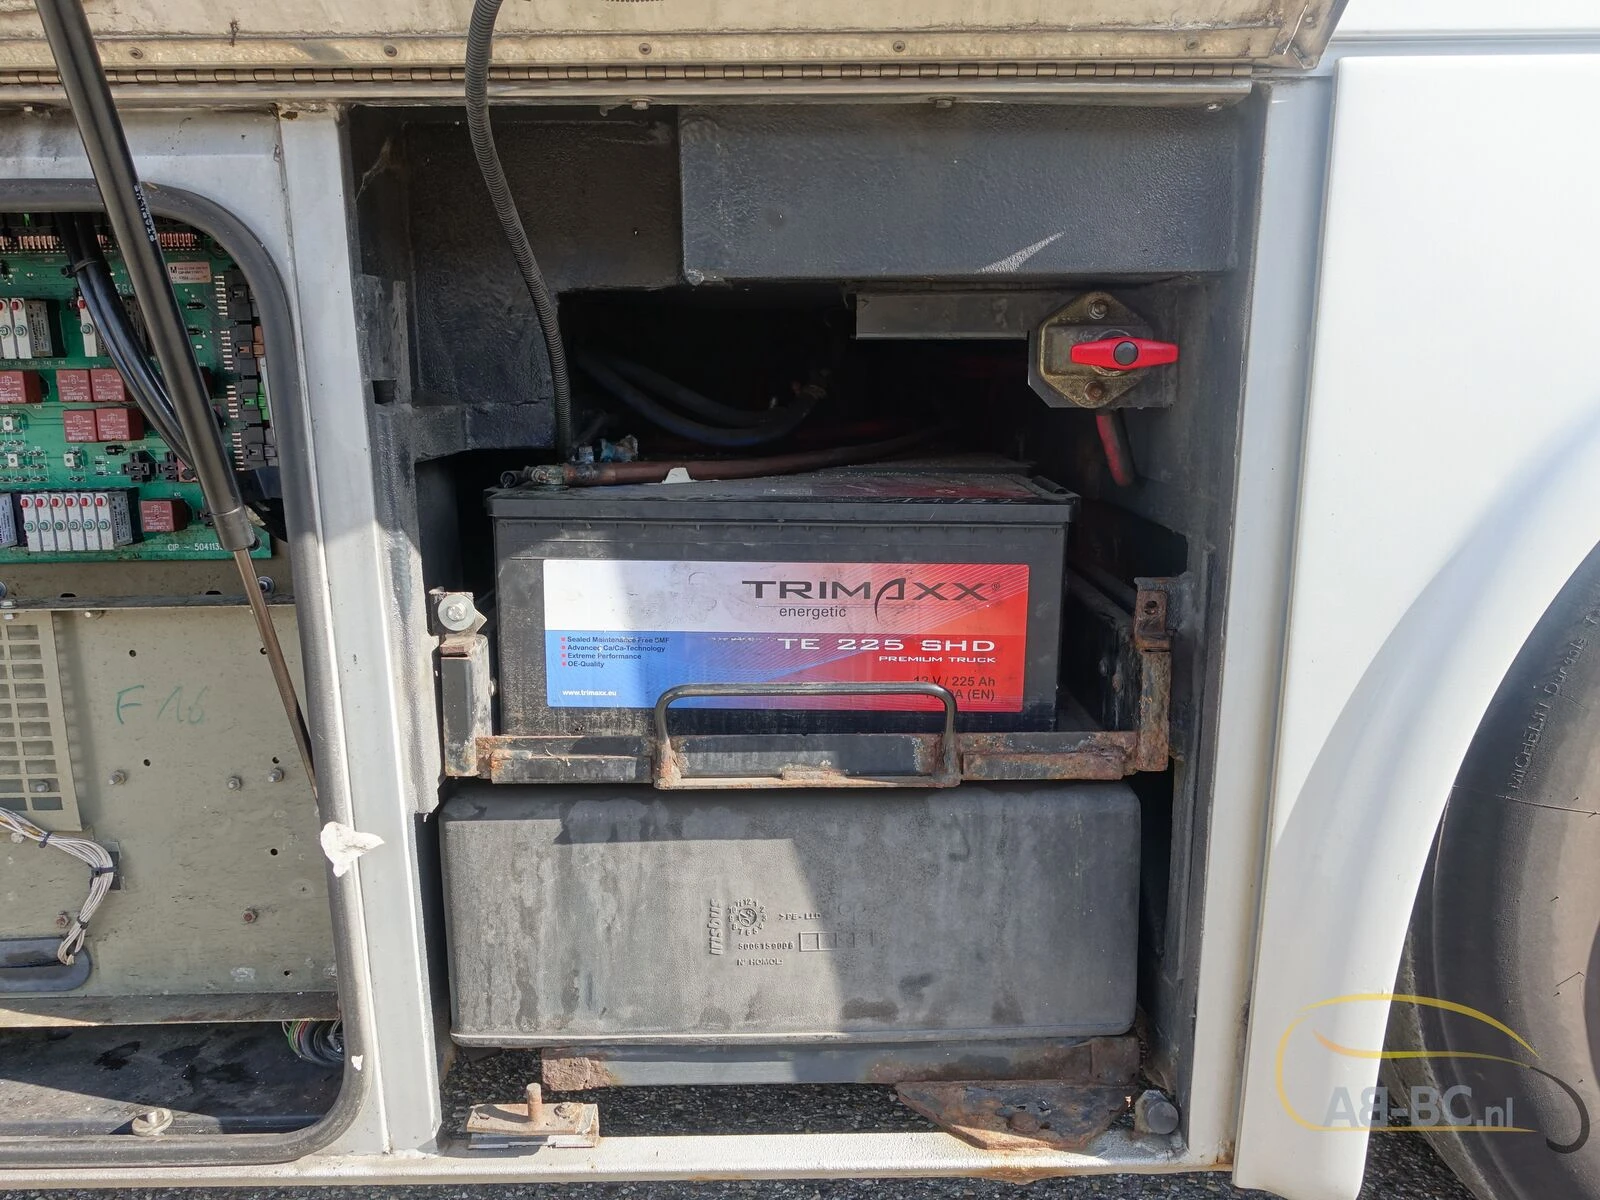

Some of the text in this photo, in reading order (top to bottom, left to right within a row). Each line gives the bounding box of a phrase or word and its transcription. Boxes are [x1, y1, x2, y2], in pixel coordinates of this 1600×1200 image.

[742, 578, 989, 622] TRIMAXX
[779, 605, 847, 619] energetic
[777, 638, 820, 650] TE
[837, 639, 905, 651] 225
[921, 640, 995, 652] SHD
[951, 677, 975, 686] 225
[978, 676, 996, 686] Ah
[967, 689, 995, 701] (EN)
[116, 684, 145, 725] F
